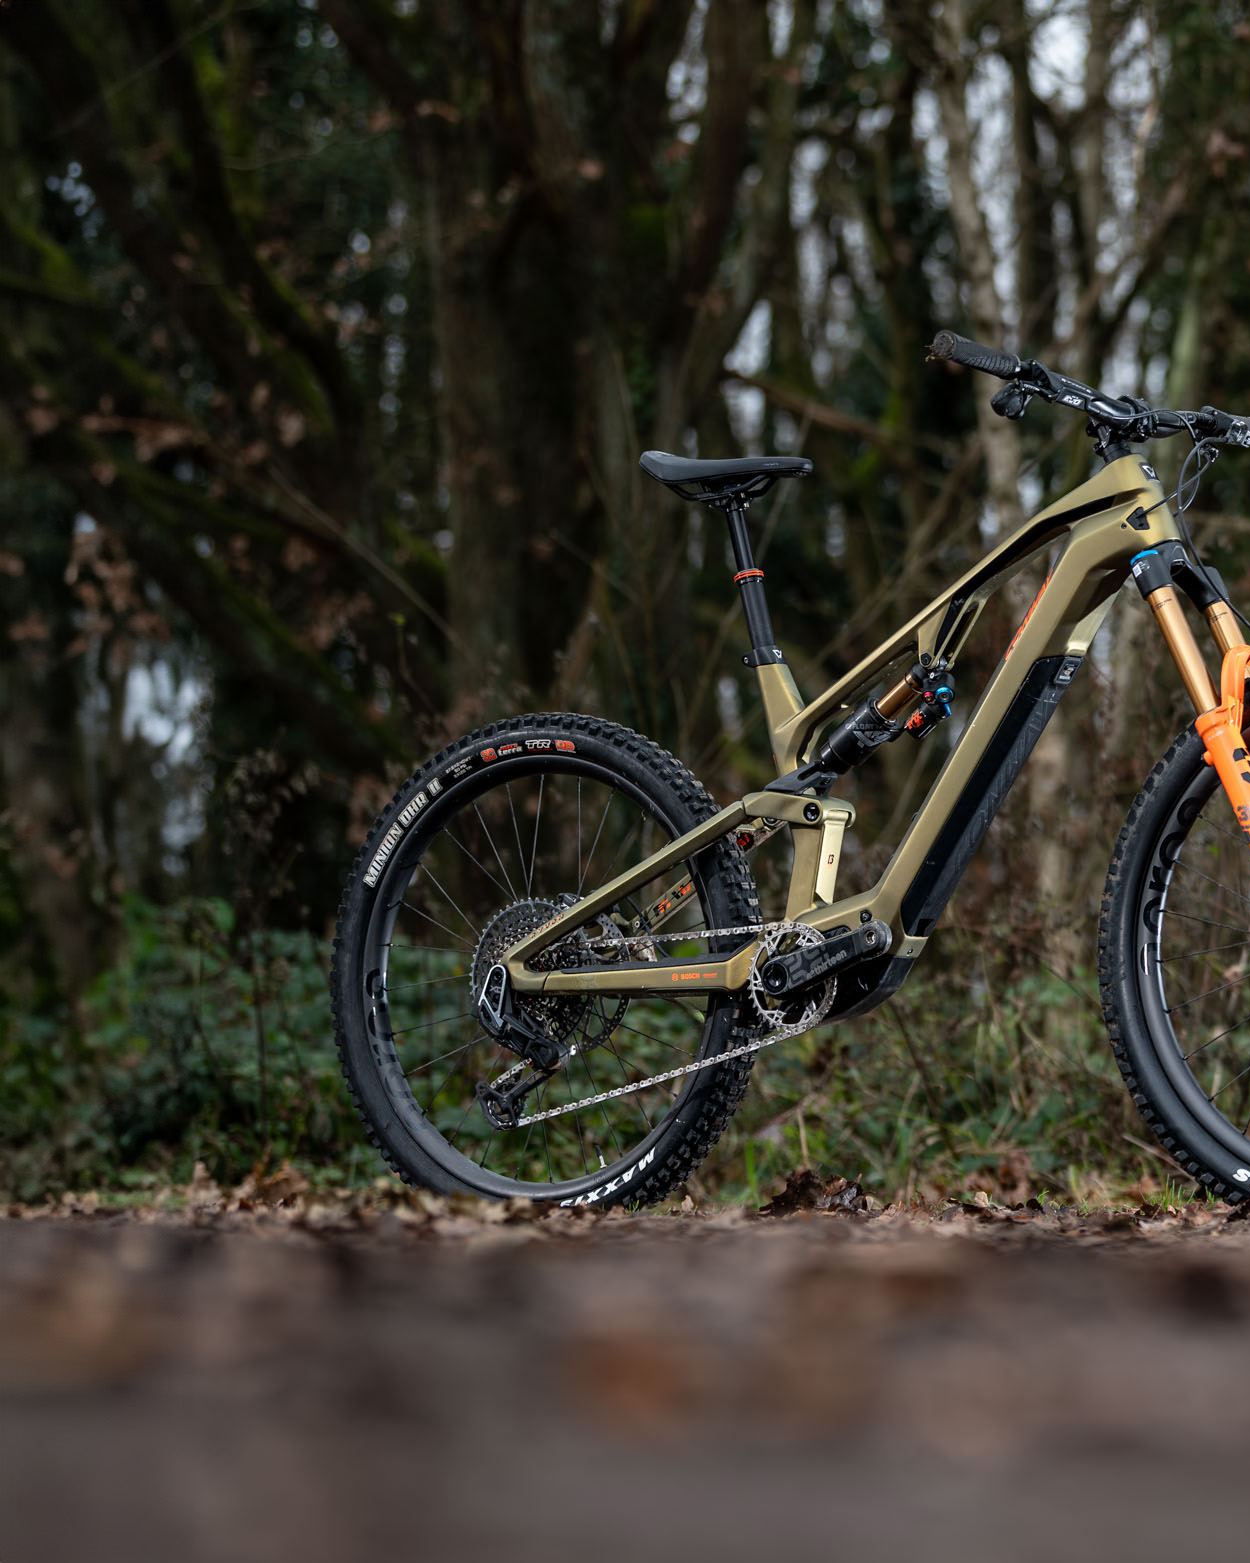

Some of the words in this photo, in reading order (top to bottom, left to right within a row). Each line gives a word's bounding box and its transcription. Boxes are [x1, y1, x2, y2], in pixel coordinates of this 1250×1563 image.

[525, 739, 551, 749] TR
[498, 746, 523, 756] terra
[363, 822, 404, 888] MINION
[398, 791, 429, 828] DHR
